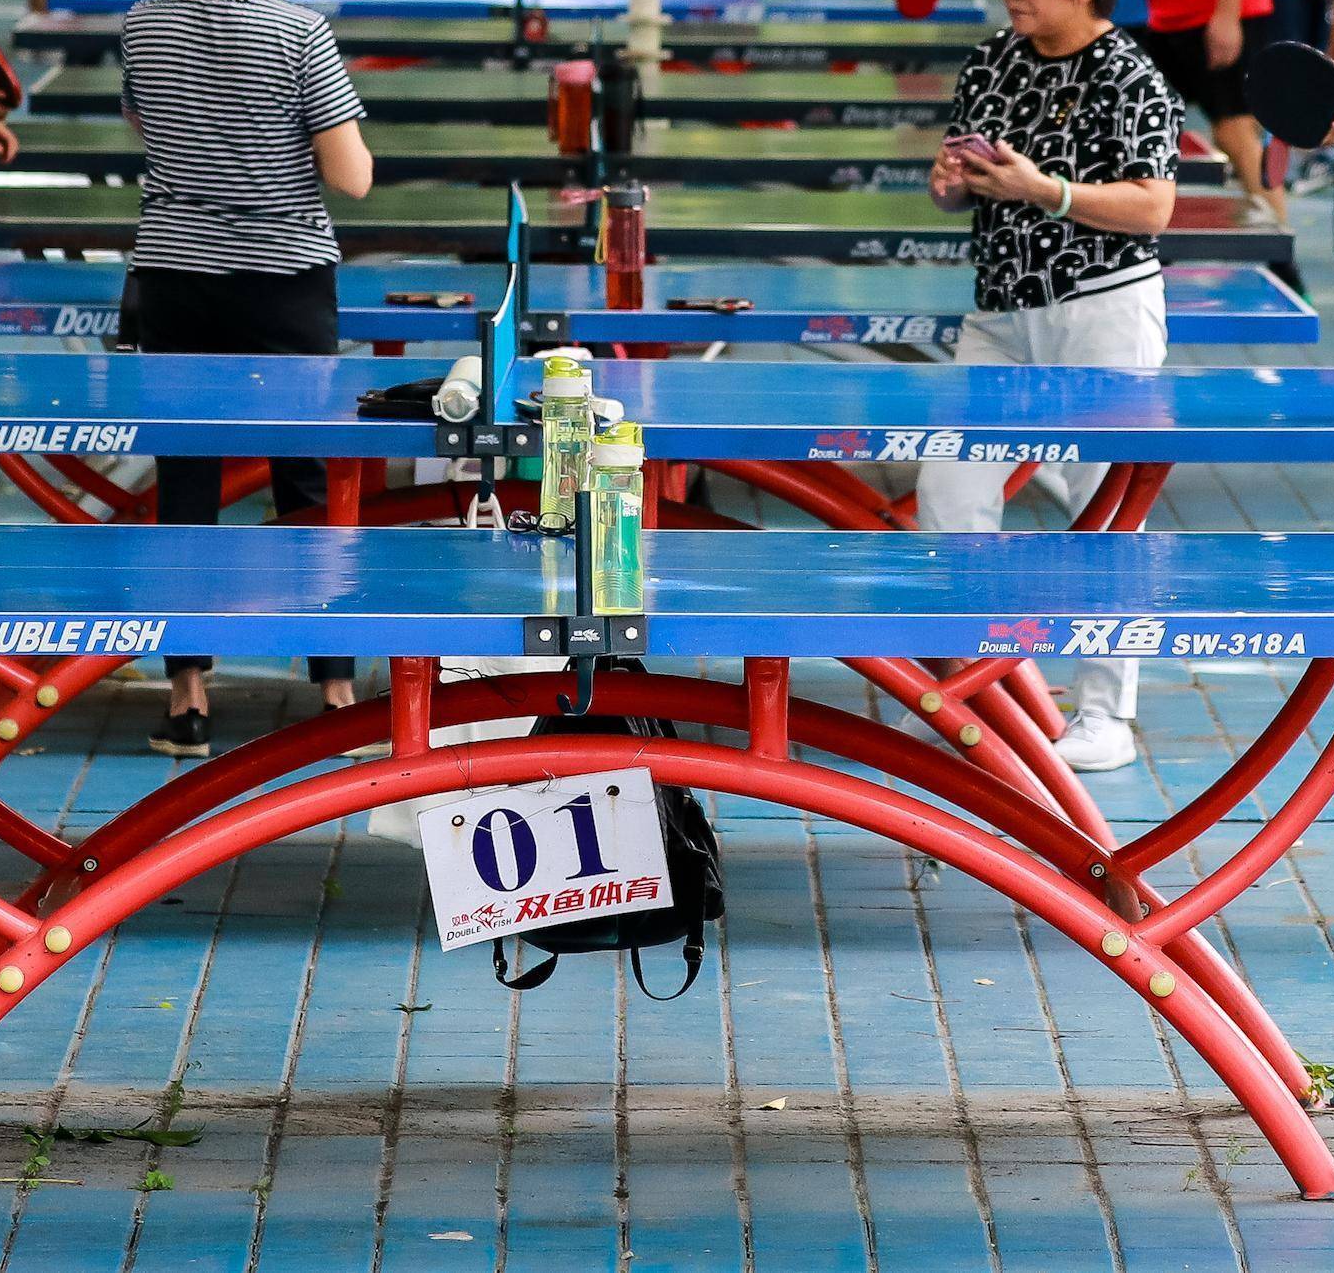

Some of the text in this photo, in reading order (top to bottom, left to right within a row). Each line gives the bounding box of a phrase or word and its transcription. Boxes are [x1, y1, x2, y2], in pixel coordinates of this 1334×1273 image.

[861, 316, 937, 343] 双鱼
[70, 426, 138, 452] FISH
[876, 430, 1080, 462] 双鱼 SW-318A
[85, 620, 167, 652] FISH
[978, 641, 1055, 653] DOUBLE FISH
[1060, 617, 1306, 655] 双鱼 SW-318A
[472, 791, 619, 893] 01
[514, 877, 662, 924] 双鱼体育
[446, 918, 512, 941] DOUBLE FISH
